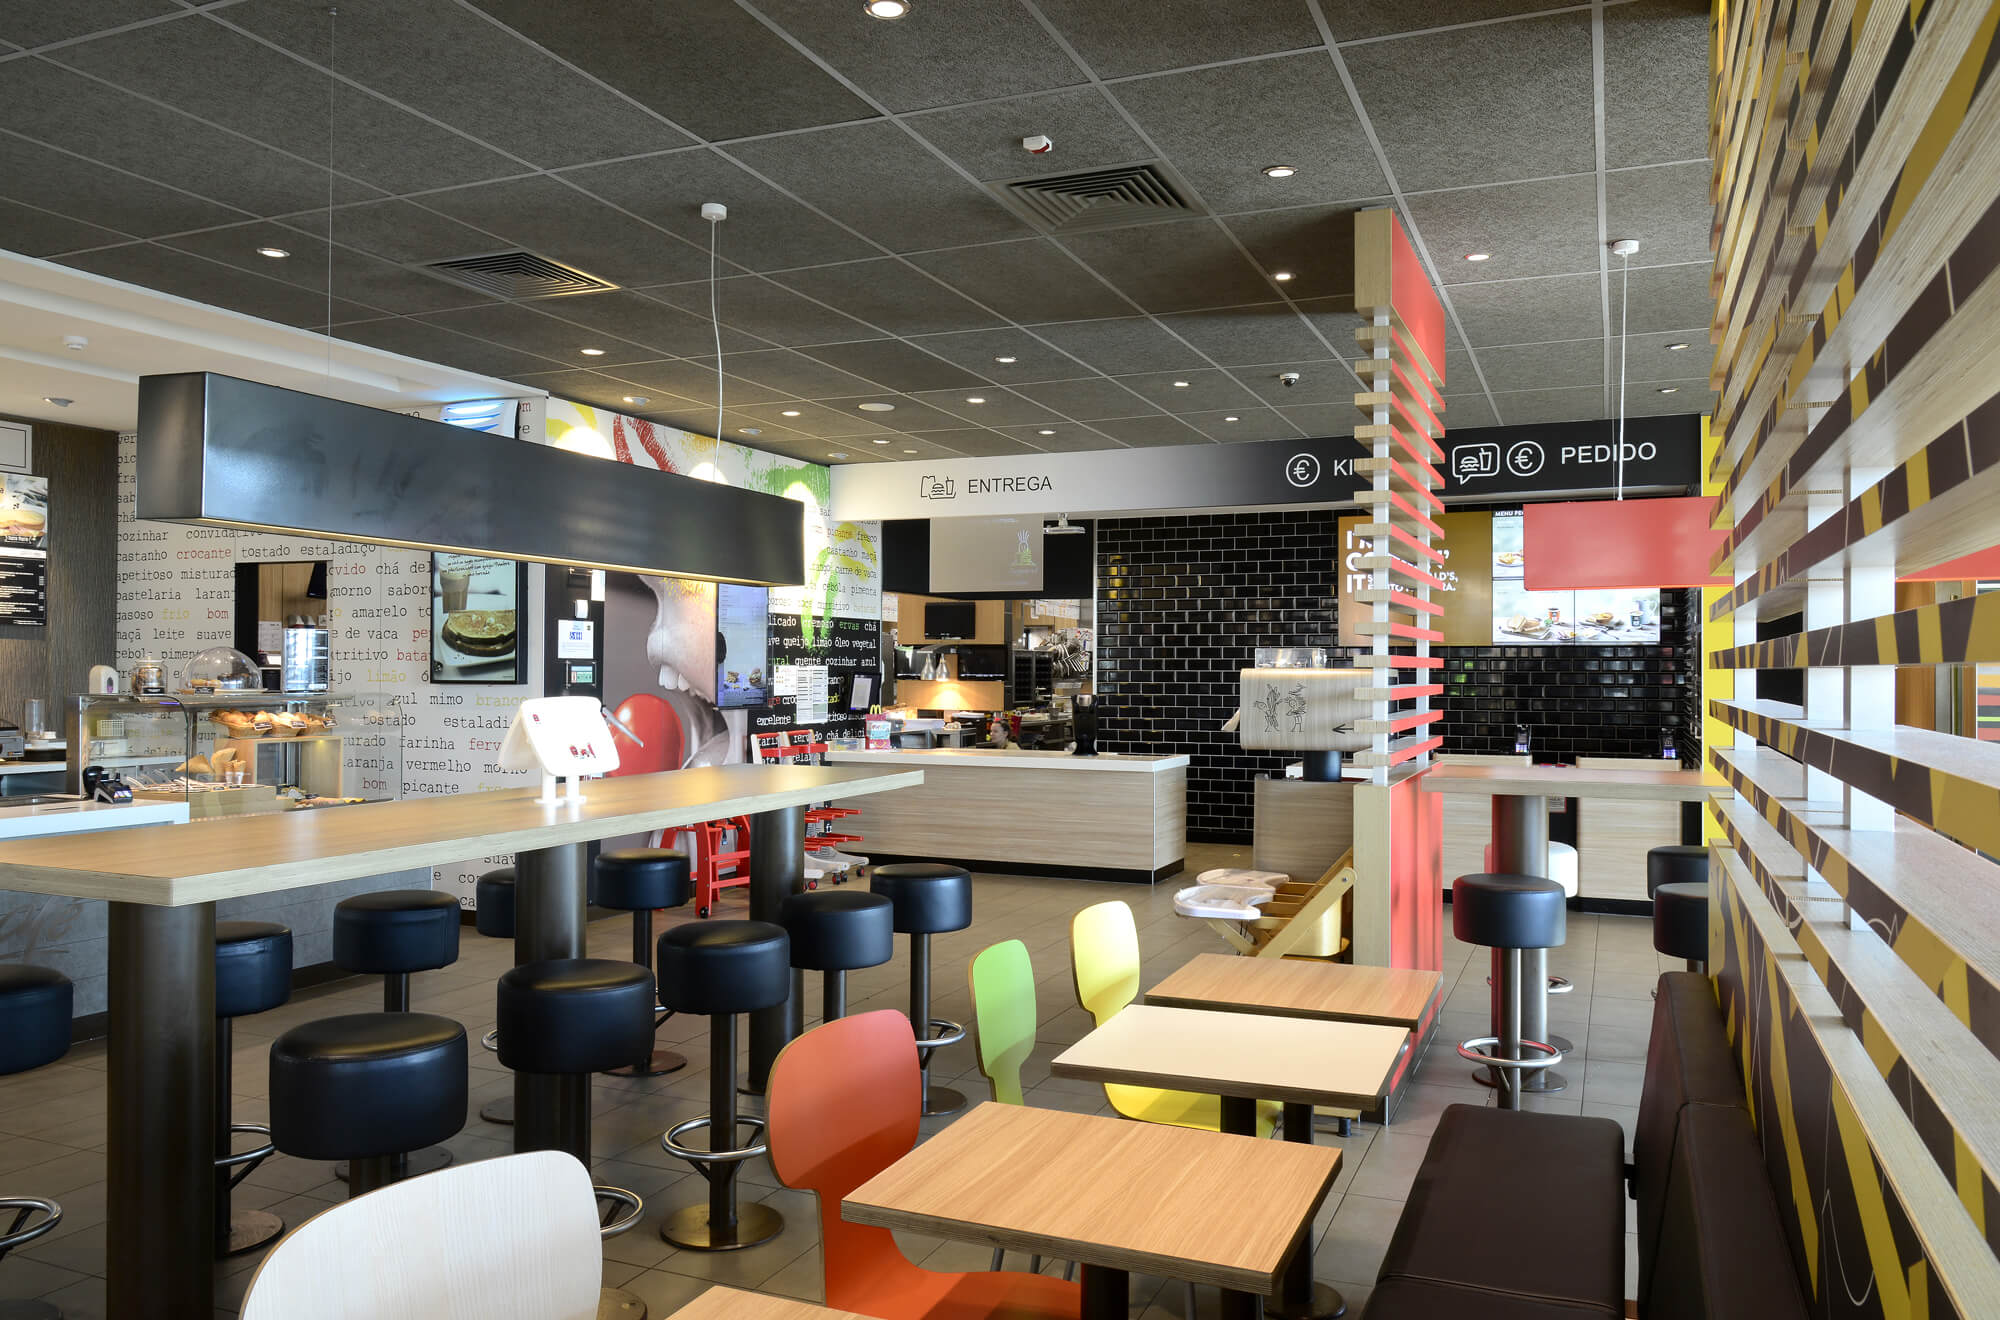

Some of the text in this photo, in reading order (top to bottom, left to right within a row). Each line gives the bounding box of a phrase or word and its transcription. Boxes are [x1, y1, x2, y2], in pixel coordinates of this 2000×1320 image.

[1561, 442, 1657, 464] PEDIDO
[968, 475, 1052, 494] ENTREGA
[117, 543, 376, 562] castanho crocante tostado estaladiço
[116, 567, 236, 583] apetitoso misturad
[376, 562, 399, 575] chá
[195, 588, 236, 602] laran
[162, 608, 190, 620] frio
[207, 608, 229, 619] bom
[352, 605, 407, 618] amarelo
[839, 621, 860, 631] ervas
[153, 628, 185, 642] leite
[196, 629, 232, 640] suave
[345, 627, 360, 639] de
[368, 630, 398, 640] vaca
[835, 636, 850, 648] óleo
[852, 638, 877, 650] vegetal
[825, 656, 857, 667] cozinhar
[861, 656, 877, 667] azul
[367, 669, 407, 682] limão
[430, 693, 463, 705] mimo
[476, 693, 529, 707] branco
[363, 714, 416, 727] tostado
[756, 714, 792, 725] excelente
[400, 735, 455, 750] farinha
[344, 757, 394, 771] aranja
[406, 759, 471, 774] vermelho
[362, 777, 460, 795] bom picante
